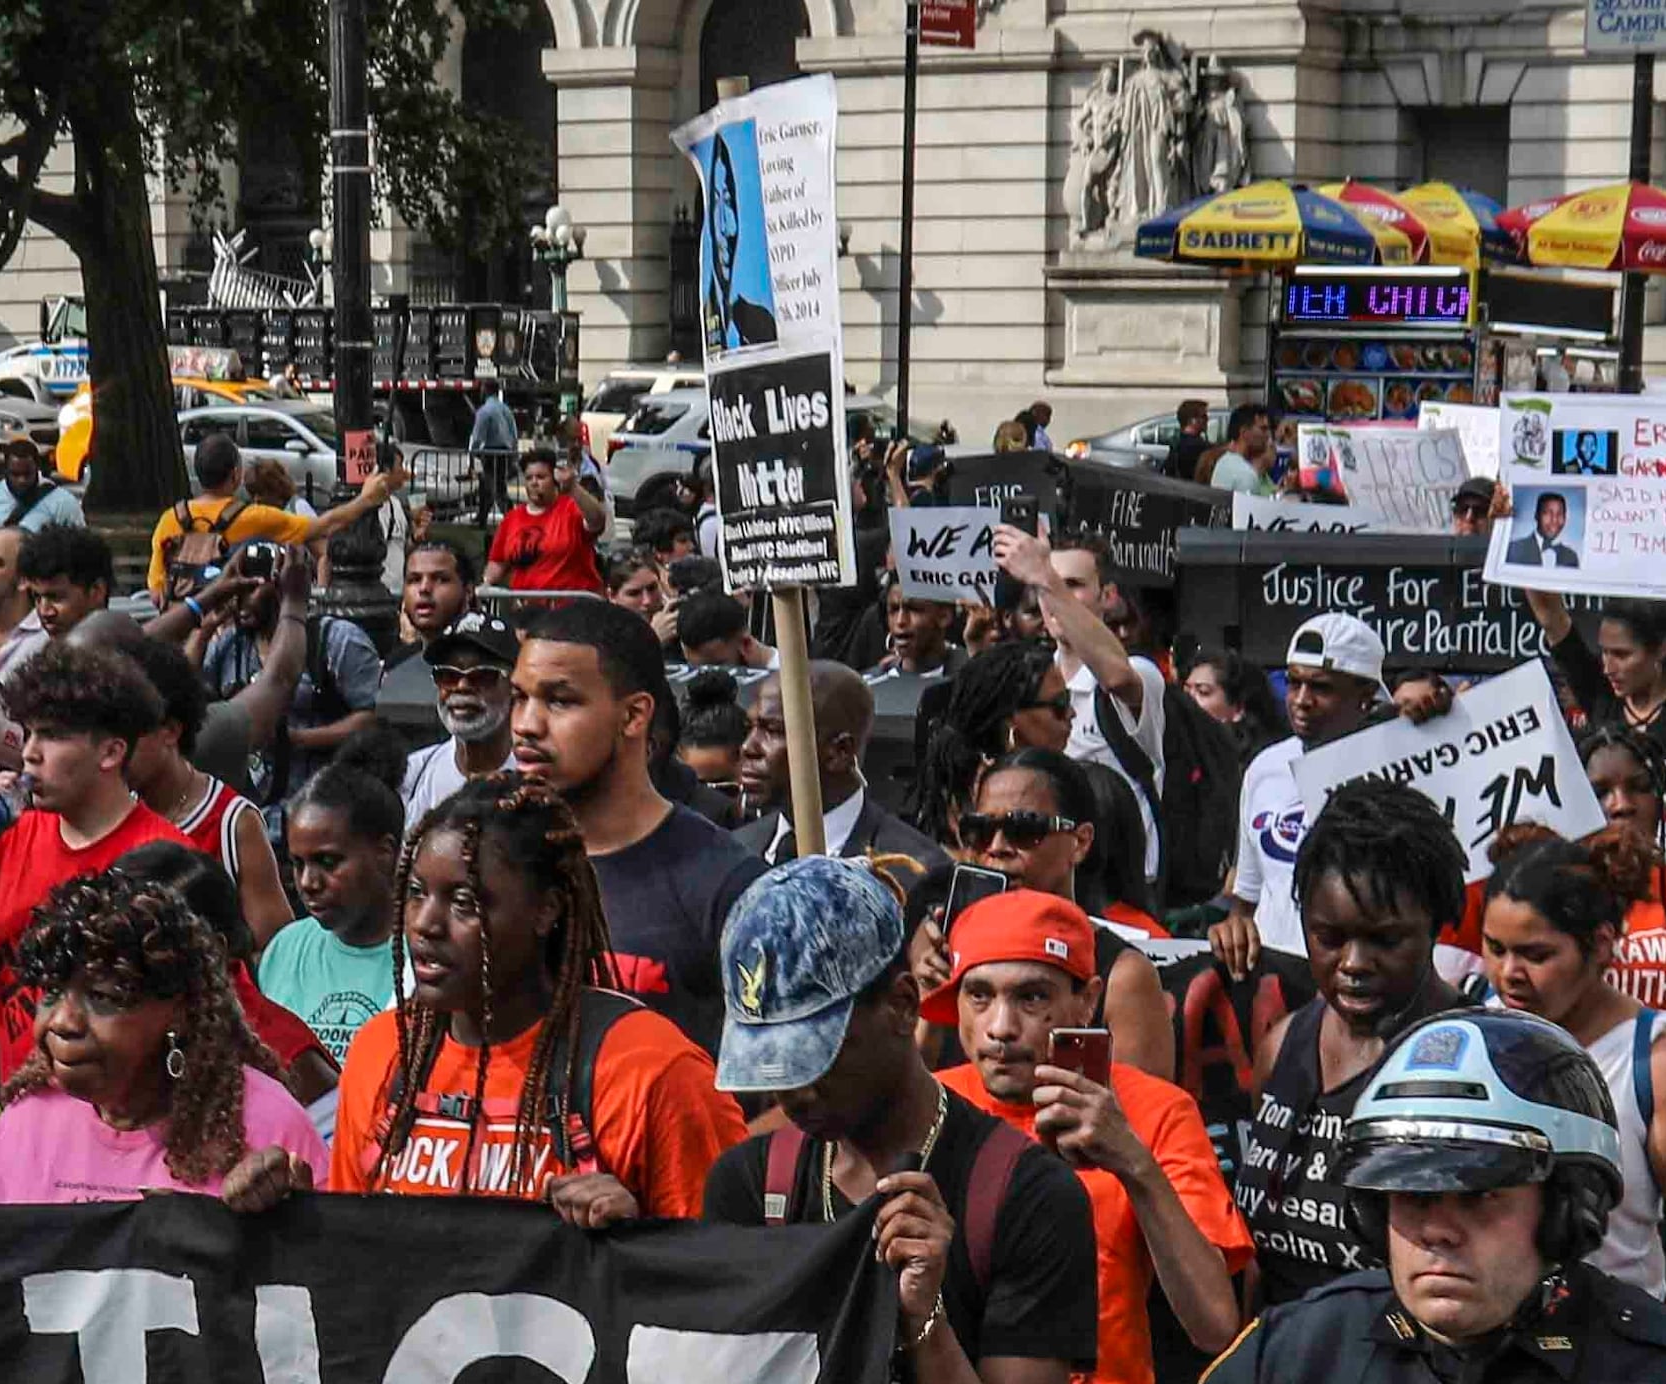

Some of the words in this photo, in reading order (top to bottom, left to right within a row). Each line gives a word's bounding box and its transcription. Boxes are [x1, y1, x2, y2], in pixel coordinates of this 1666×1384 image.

[1185, 232, 1293, 250] SABRETT
[712, 394, 757, 443] Black
[764, 385, 830, 435] Lives
[1112, 490, 1145, 527] FIRE
[1598, 485, 1652, 503] SAID
[907, 524, 969, 559] WE
[1594, 533, 1619, 555] 11
[910, 569, 953, 585] ERIC
[1262, 561, 1364, 608] Justice
[1464, 704, 1541, 757] ERIC
[1470, 754, 1563, 850] WE
[1306, 1151, 1328, 1181] &
